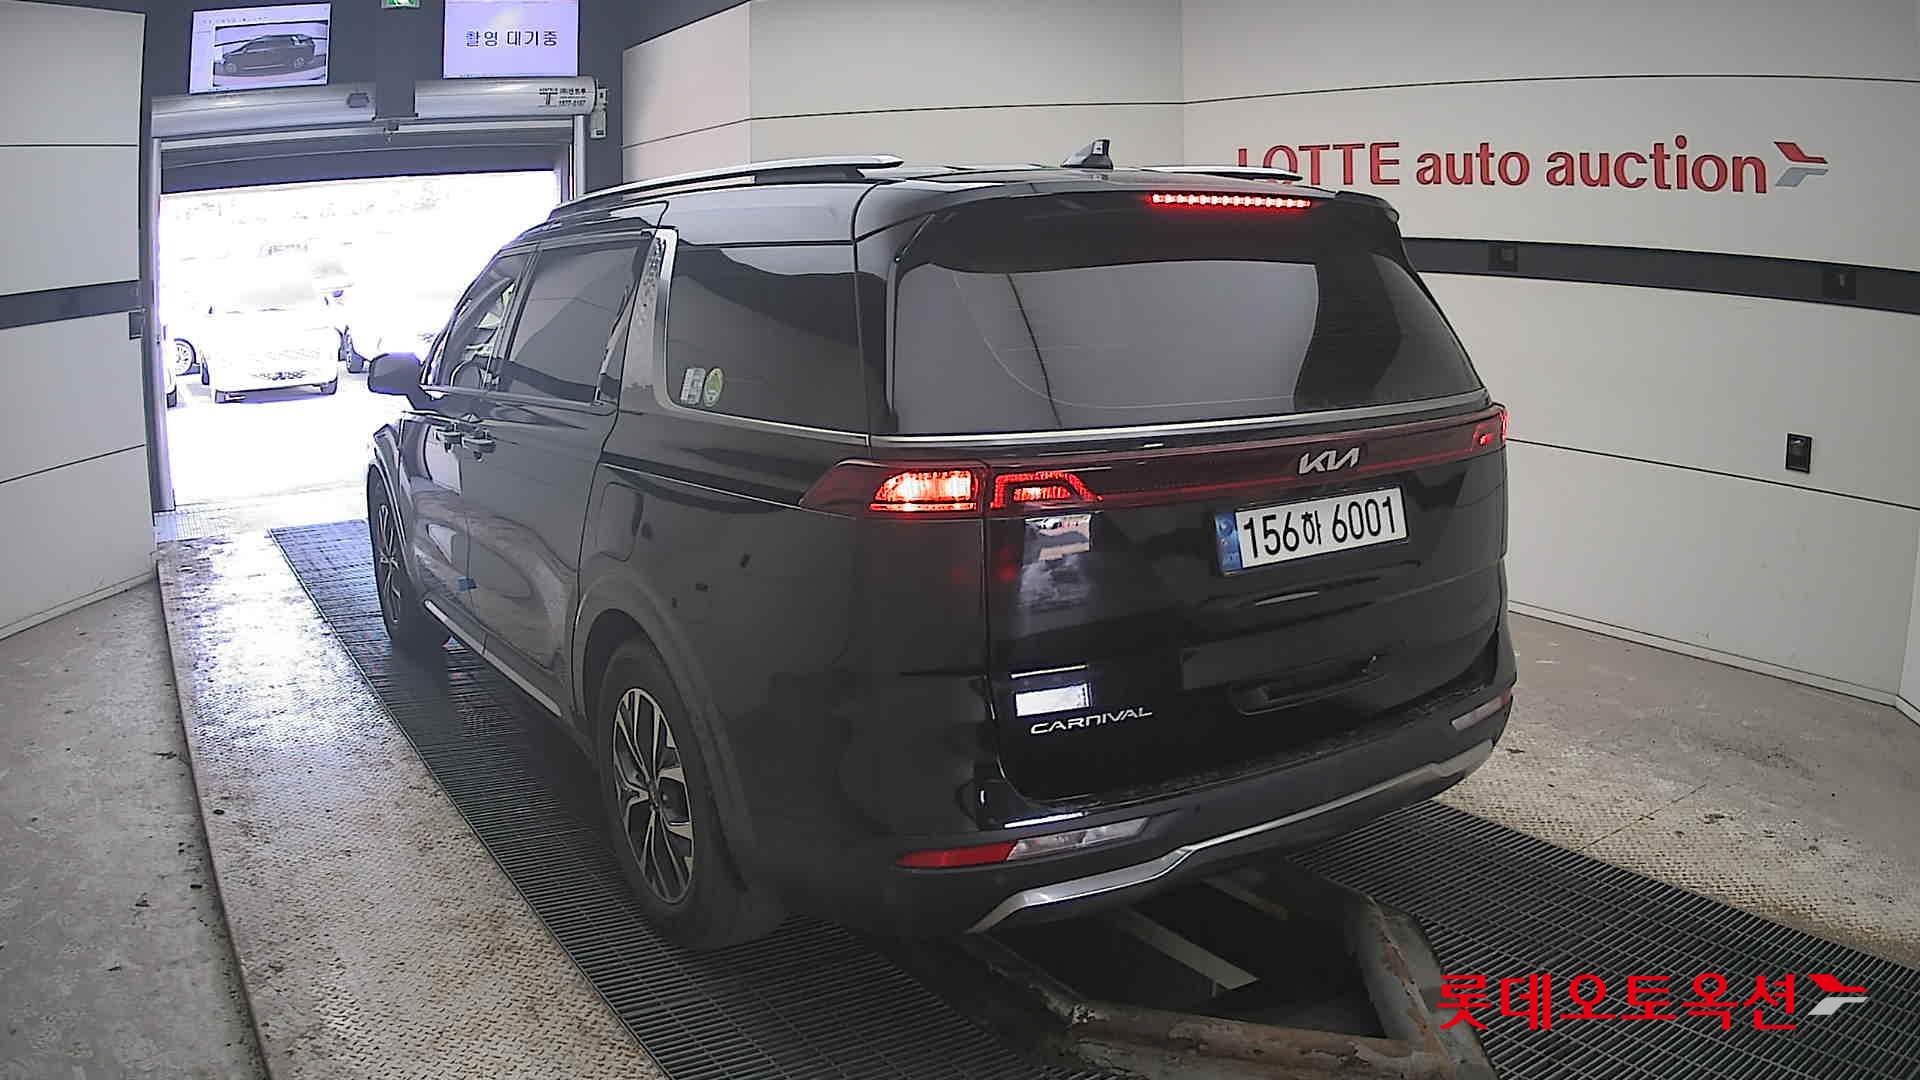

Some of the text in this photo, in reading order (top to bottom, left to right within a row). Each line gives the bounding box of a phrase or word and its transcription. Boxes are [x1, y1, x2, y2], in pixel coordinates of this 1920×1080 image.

[506, 30, 558, 47] 대기중
[1416, 142, 1530, 187] auto
[1546, 135, 1767, 194] auction
[1298, 447, 1360, 474] KIA
[1331, 496, 1396, 544] 6001
[1030, 707, 1153, 735] CARNIVAL
